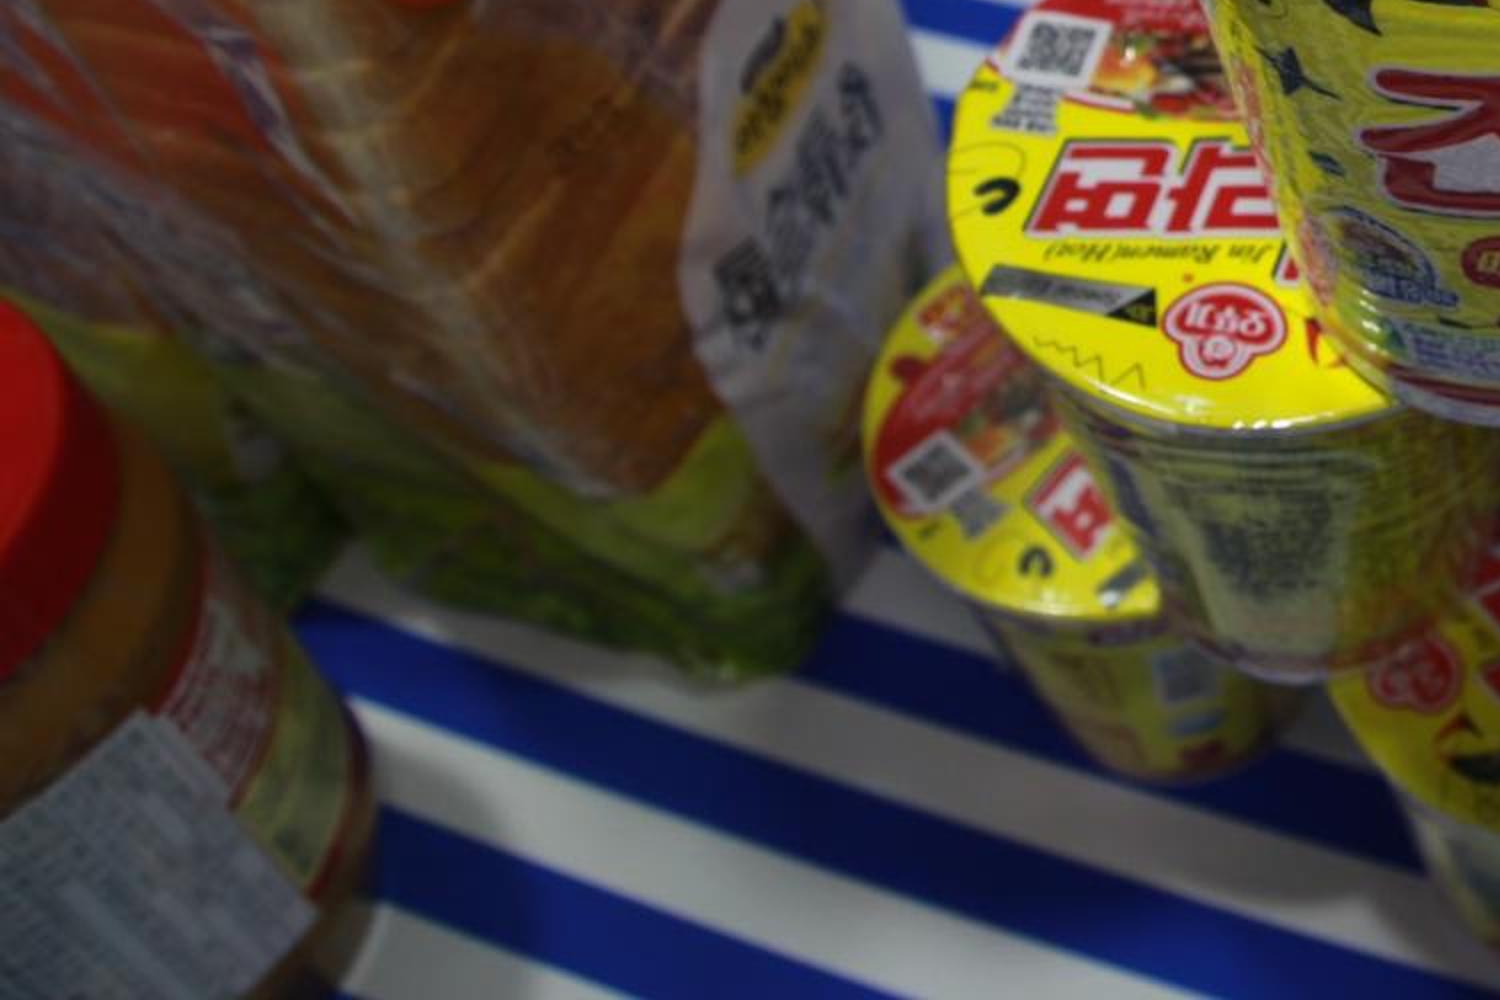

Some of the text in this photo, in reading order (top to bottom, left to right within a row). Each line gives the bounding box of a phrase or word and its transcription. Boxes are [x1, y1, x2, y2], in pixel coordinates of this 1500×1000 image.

[1031, 143, 1284, 236] 라면
[1227, 243, 1274, 263] Jin
[1184, 302, 1269, 336] 오뚜기
